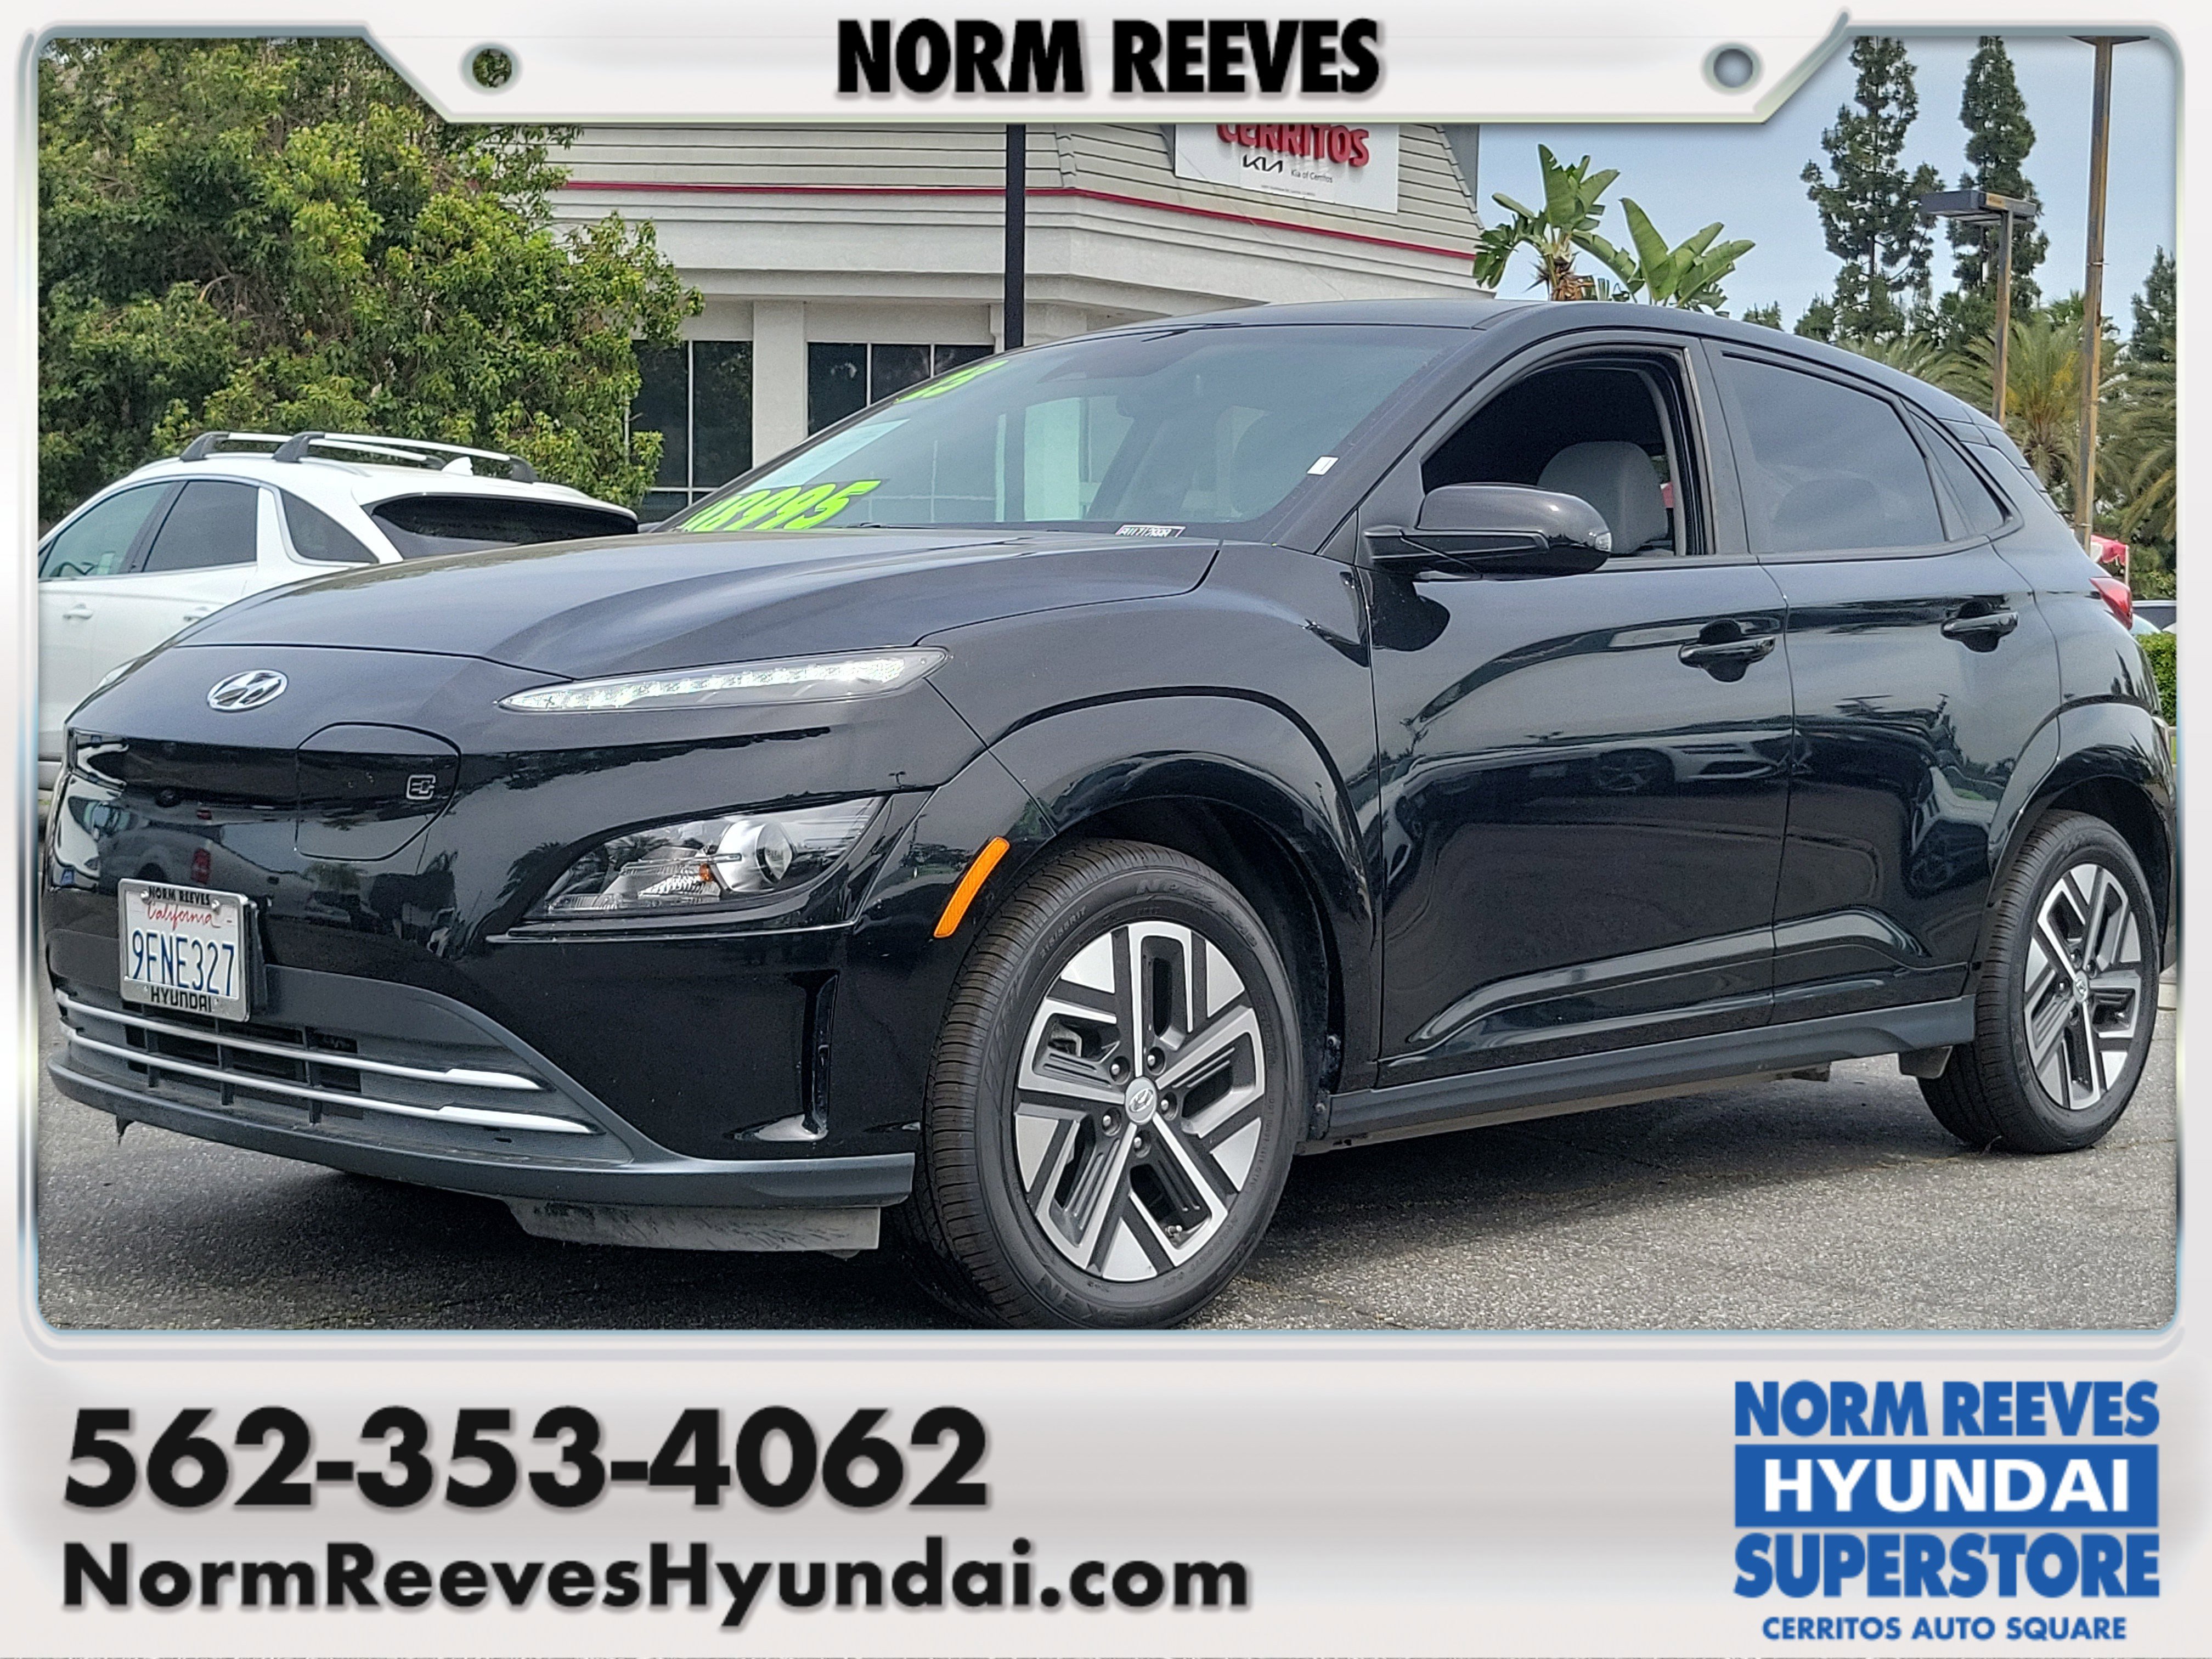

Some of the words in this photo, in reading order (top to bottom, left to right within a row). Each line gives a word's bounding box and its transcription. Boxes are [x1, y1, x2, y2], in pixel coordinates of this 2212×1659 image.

[1216, 123, 1369, 167] CERRITOS
[1291, 169, 1301, 178] Kia
[1302, 171, 1310, 180] of
[1310, 172, 1333, 183] Cerritos
[678, 480, 882, 532] 18995
[149, 885, 176, 901] NORM
[179, 890, 210, 906] REEVES
[147, 900, 221, 931] California
[133, 929, 234, 997] 9FNE327
[151, 986, 213, 1013] HYUNDAI
